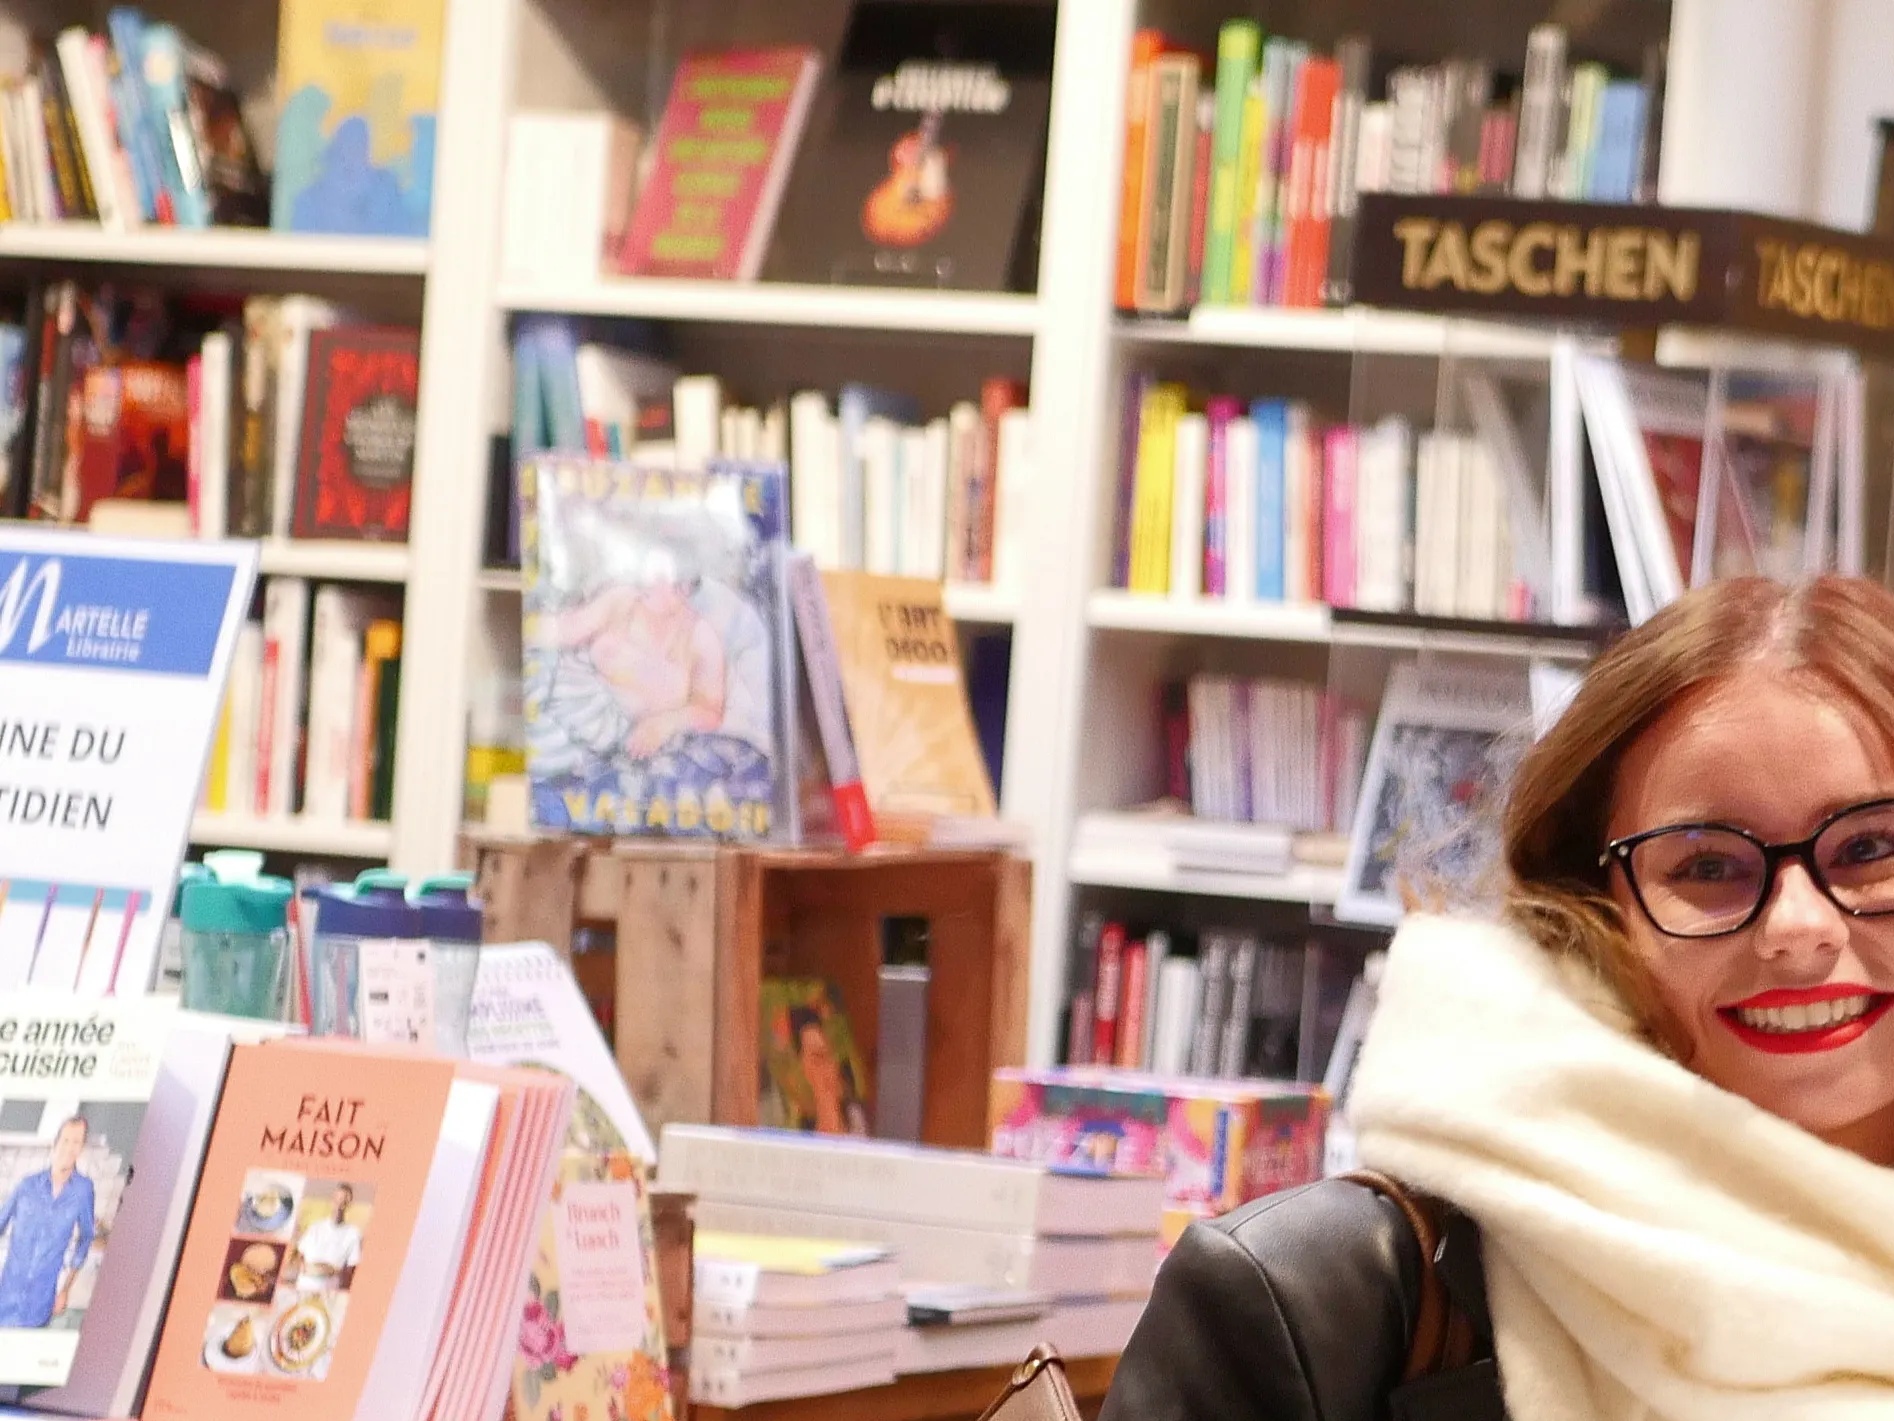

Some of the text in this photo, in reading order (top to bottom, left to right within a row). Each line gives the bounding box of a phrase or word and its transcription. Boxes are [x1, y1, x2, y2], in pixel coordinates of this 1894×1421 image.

[1394, 217, 1699, 302] TASCHEN
[68, 726, 126, 764] DU
[23, 1011, 116, 1046] année
[296, 1092, 365, 1125] FAIT
[260, 1124, 386, 1164] MAISON
